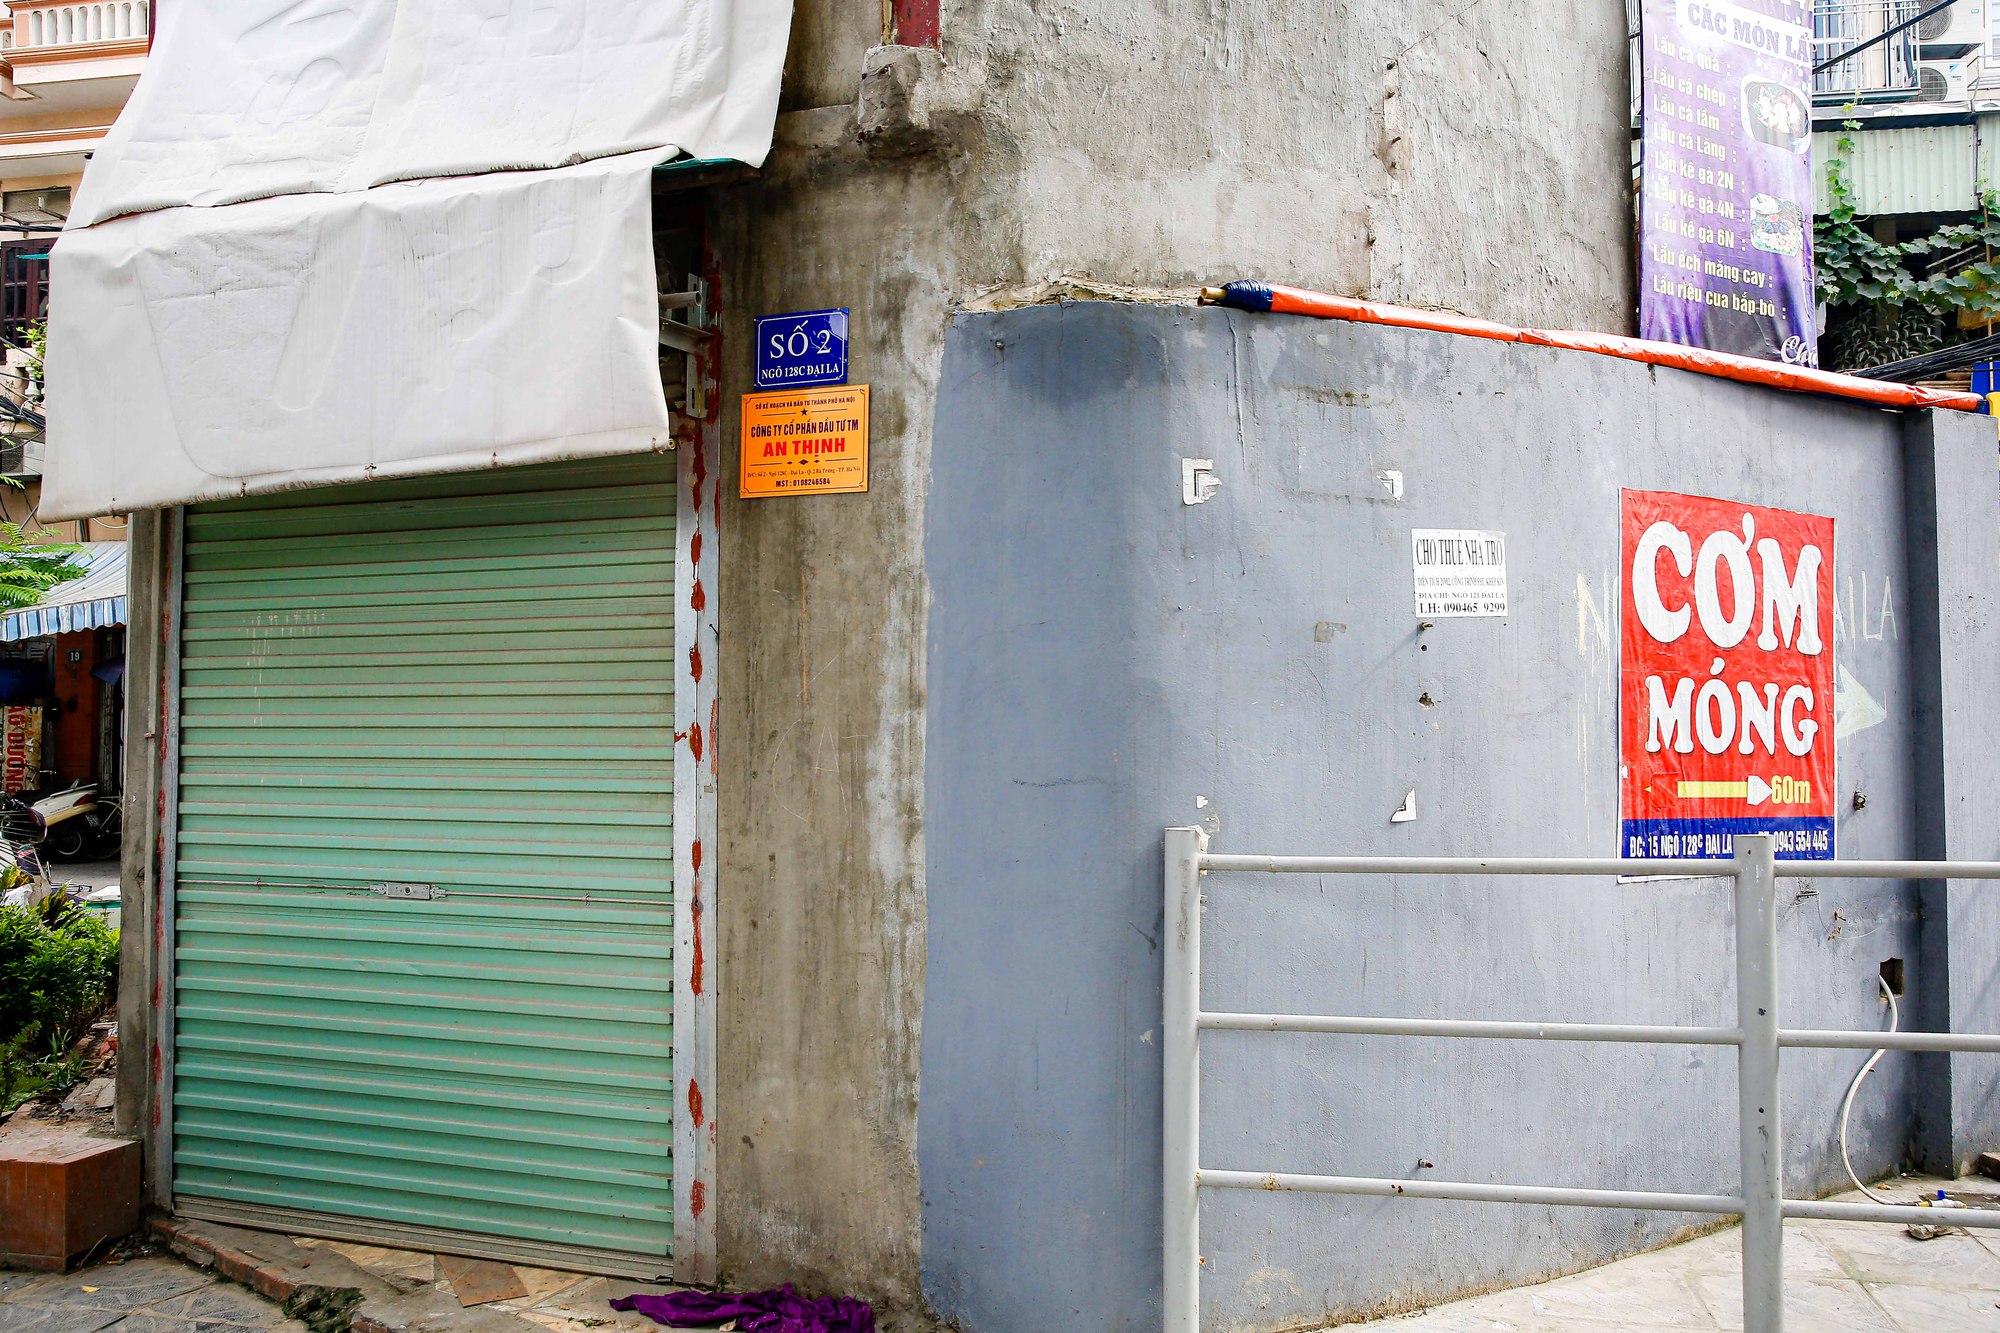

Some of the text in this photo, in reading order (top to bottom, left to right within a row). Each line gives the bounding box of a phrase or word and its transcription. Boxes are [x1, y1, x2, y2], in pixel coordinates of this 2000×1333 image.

[1688, 3, 1727, 35] CÁC
[1733, 21, 1780, 54] MÓN
[1653, 34, 1676, 56] Lẩu
[1678, 44, 1694, 64] cá
[1653, 65, 1726, 107] Lẩu cá chép
[1653, 93, 1720, 130] Lẩu cá tầm
[1653, 121, 1726, 162] Lẩu cá Lăng
[1654, 150, 1734, 190] Lẩu kê gà 2N
[1680, 188, 1695, 209] kê
[1698, 196, 1714, 215] gà
[1718, 200, 1734, 219] 4N
[1654, 211, 1735, 248] Lẩu kê gà 6N
[1653, 243, 1765, 289] Lẩu ếch măng cay
[1653, 273, 1675, 296] Lẩu
[1705, 291, 1729, 309] cua
[1732, 291, 1756, 316] bắp
[1759, 298, 1775, 318] bò
[770, 319, 832, 359] SỐ 2
[761, 361, 840, 380] NGÕ 128C ĐẠI LA
[751, 423, 772, 438] CÔNG
[773, 424, 783, 436] TY
[783, 419, 795, 436] CỔ
[836, 419, 847, 431] TƯ
[847, 419, 859, 431] TM
[763, 437, 846, 458] AN THỊNH
[776, 479, 788, 487] MST
[1416, 538, 1437, 566] CHO
[1464, 533, 1484, 566] NHÀ
[1632, 511, 1823, 656] CƠM
[1443, 602, 1478, 613] 090465
[1483, 603, 1506, 613] 9299
[70, 651, 80, 661] 19
[1644, 656, 1819, 757] MÓNG
[1770, 775, 1811, 804] 60m
[1629, 835, 1646, 858] ĐC:
[1647, 835, 1659, 857] 15
[1660, 831, 1680, 859] NGÕ
[1705, 834, 1720, 859] ĐẠI
[1721, 833, 1733, 854] LA
[1772, 830, 1794, 852] 0943
[1795, 830, 1812, 851] 554
[1812, 829, 1829, 851] 445
